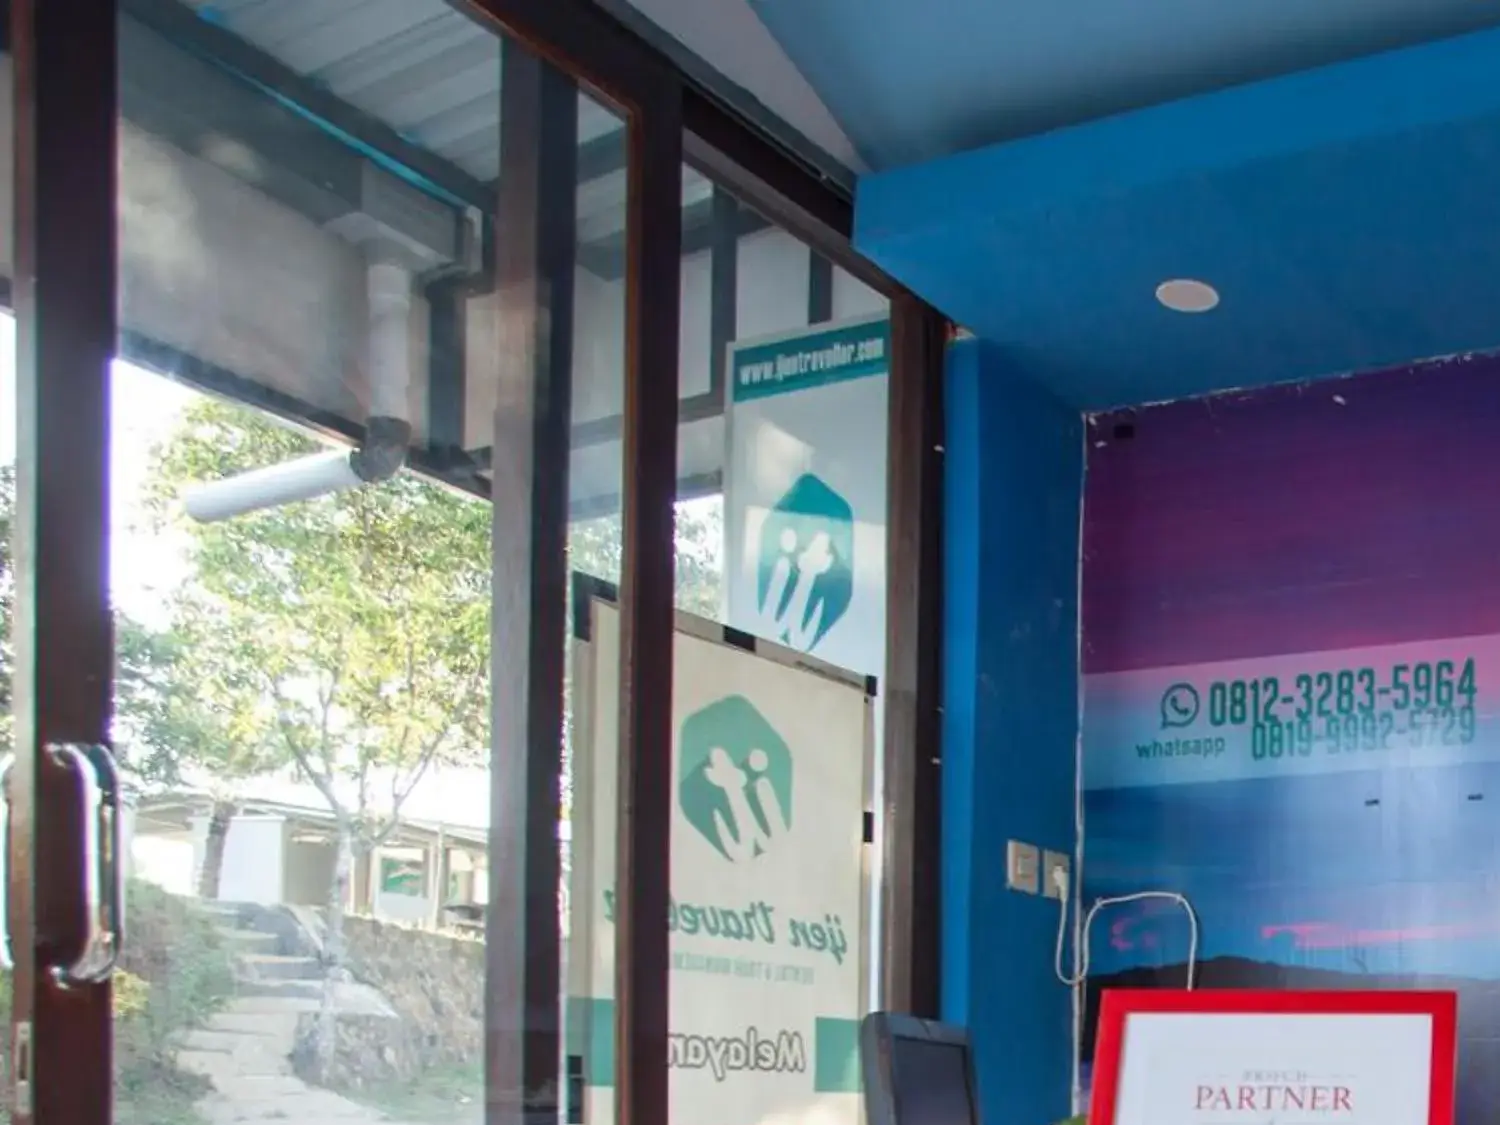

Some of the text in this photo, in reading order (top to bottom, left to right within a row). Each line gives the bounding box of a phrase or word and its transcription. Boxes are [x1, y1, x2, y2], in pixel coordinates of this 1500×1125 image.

[1208, 656, 1477, 726] 0812-3283-5964
[1136, 735, 1226, 760] whatsapp
[1194, 1084, 1354, 1112] PARTNER
